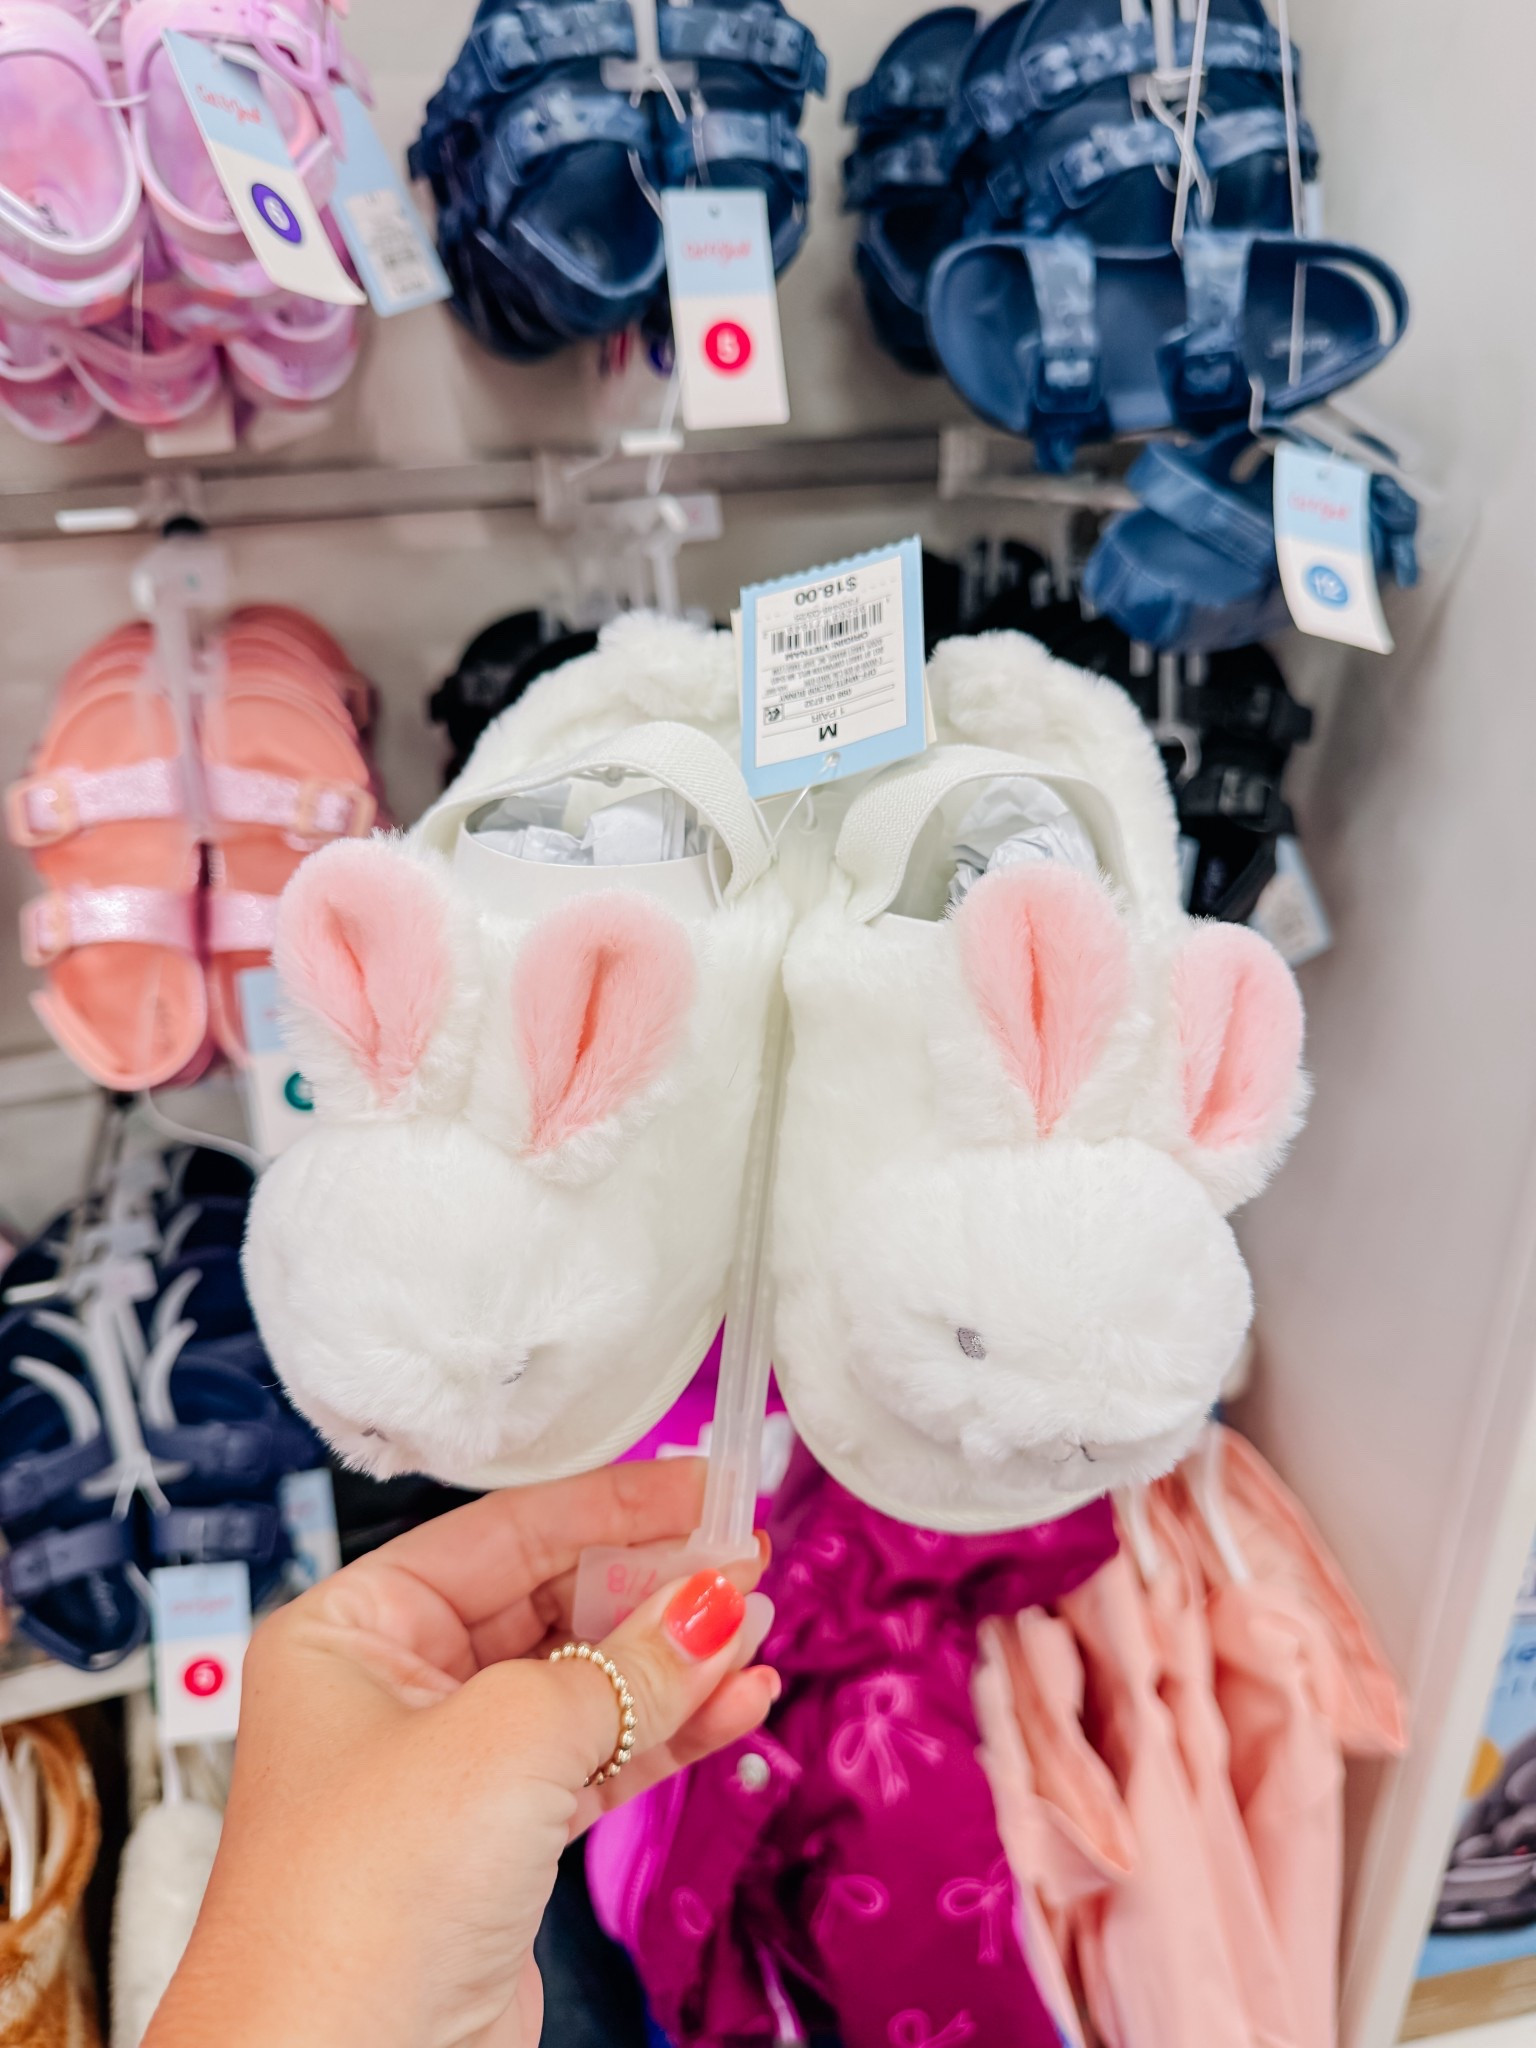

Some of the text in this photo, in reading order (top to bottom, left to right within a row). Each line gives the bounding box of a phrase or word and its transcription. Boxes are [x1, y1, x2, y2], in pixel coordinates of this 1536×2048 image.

[795, 576, 856, 606] $18.00
[834, 631, 867, 647] ORIGIN:
[785, 643, 828, 660] VIETNAM
[811, 709, 835, 723] PAIR
[819, 723, 837, 741] M
